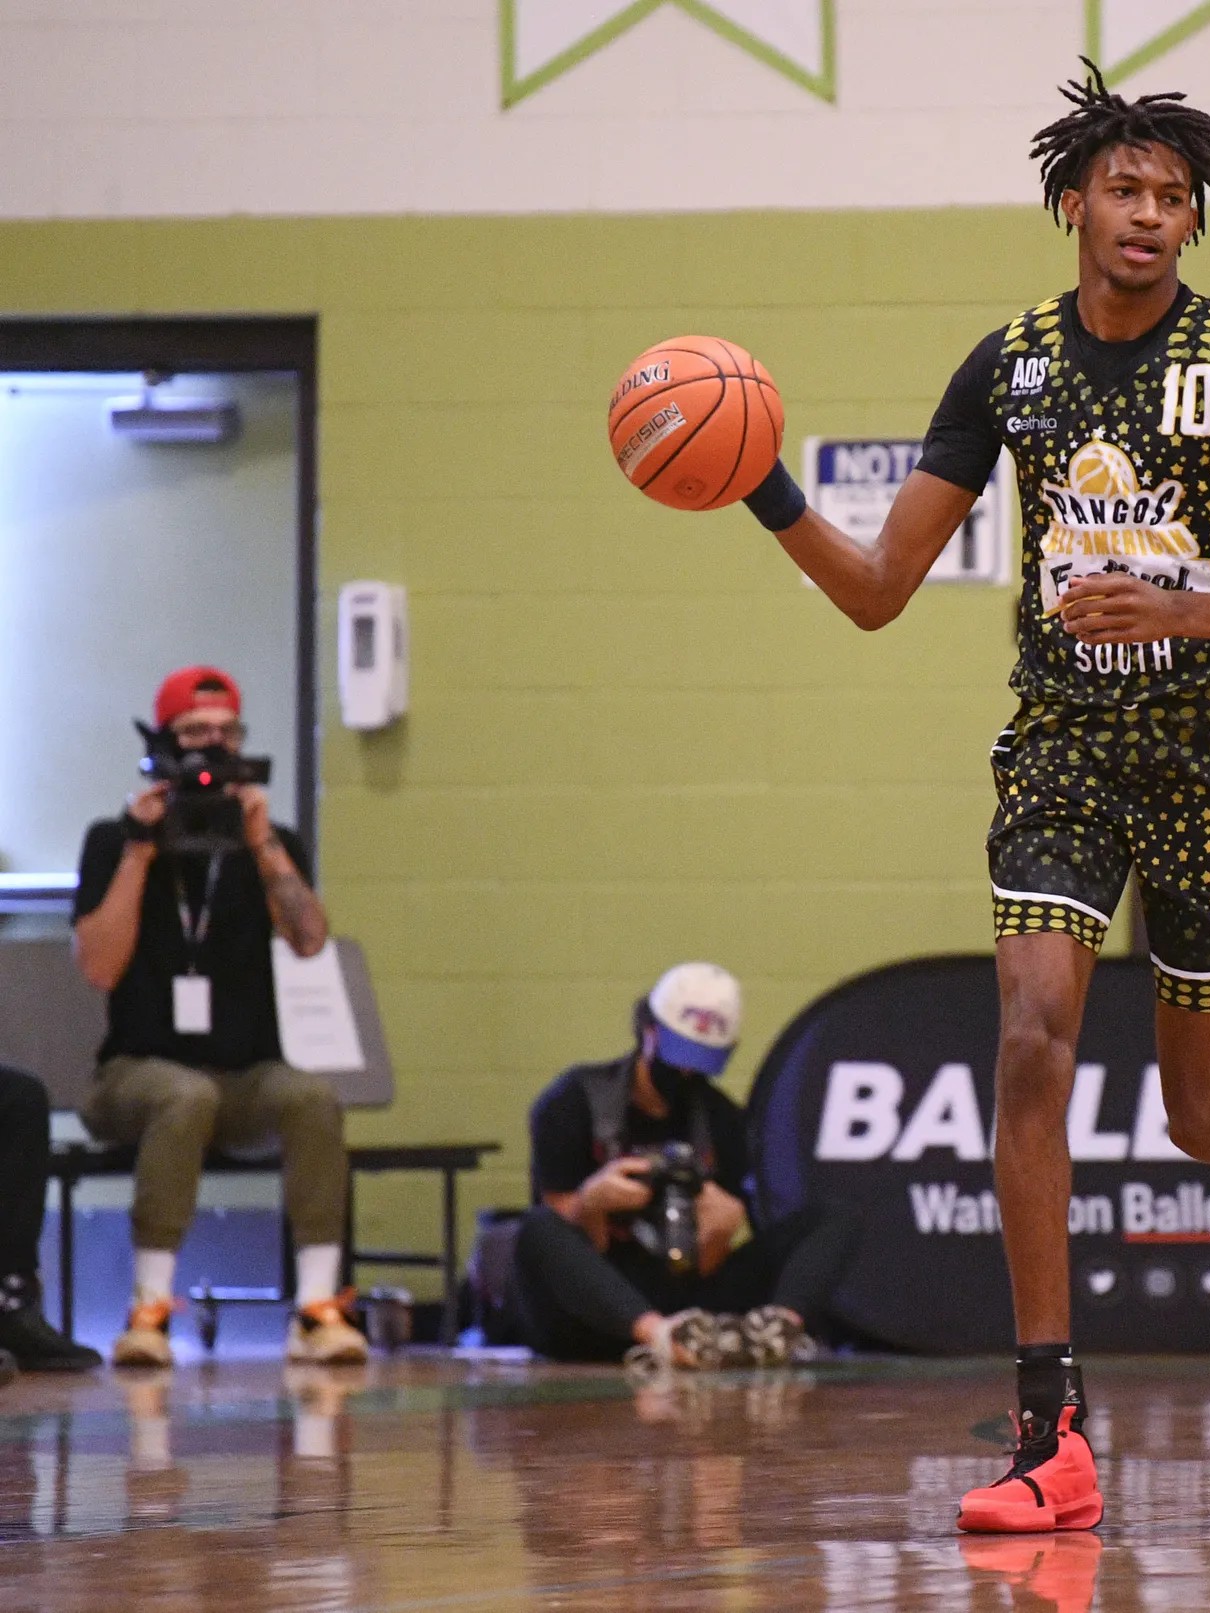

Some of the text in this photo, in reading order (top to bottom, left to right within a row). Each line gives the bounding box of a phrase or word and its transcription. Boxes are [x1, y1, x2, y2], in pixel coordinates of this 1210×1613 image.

[1011, 356, 1050, 389] AOS
[1020, 414, 1058, 431] ethika
[1045, 485, 1176, 526] PANGOS
[1045, 527, 1195, 558] ALL-AMERICAN
[1075, 637, 1173, 676] SOUTH
[908, 1182, 1003, 1235] Wat
